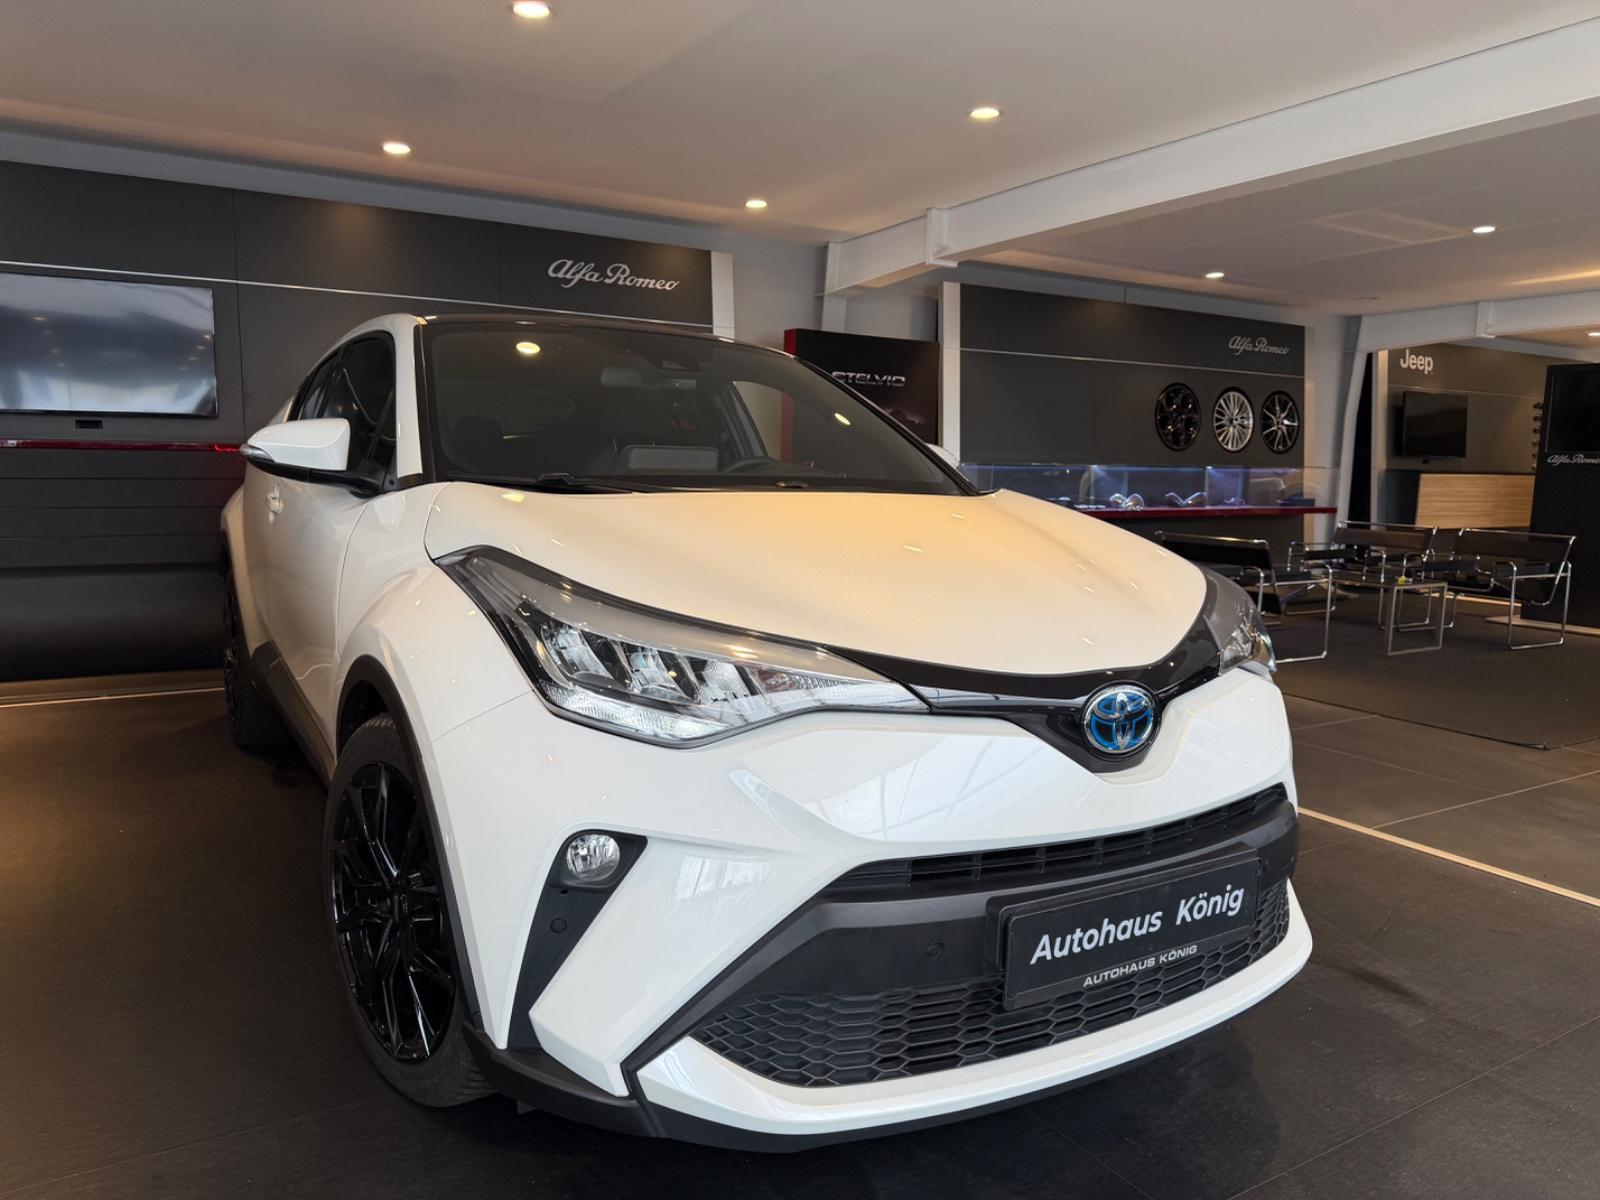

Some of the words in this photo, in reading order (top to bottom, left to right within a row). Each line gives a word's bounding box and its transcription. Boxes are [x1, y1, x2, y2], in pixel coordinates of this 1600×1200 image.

[548, 259, 602, 288] Alfa
[604, 263, 679, 290] Romeo
[1229, 336, 1253, 356] Alfa
[1254, 337, 1289, 354] Romeo
[1400, 349, 1434, 375] Jeep
[1547, 454, 1569, 467] Alfa
[1570, 453, 1600, 464] Rome
[1030, 911, 1162, 965] Autohaus
[1175, 884, 1244, 925] König
[1083, 957, 1156, 988] AUTOHAUS
[1159, 945, 1198, 964] KÖNIG
